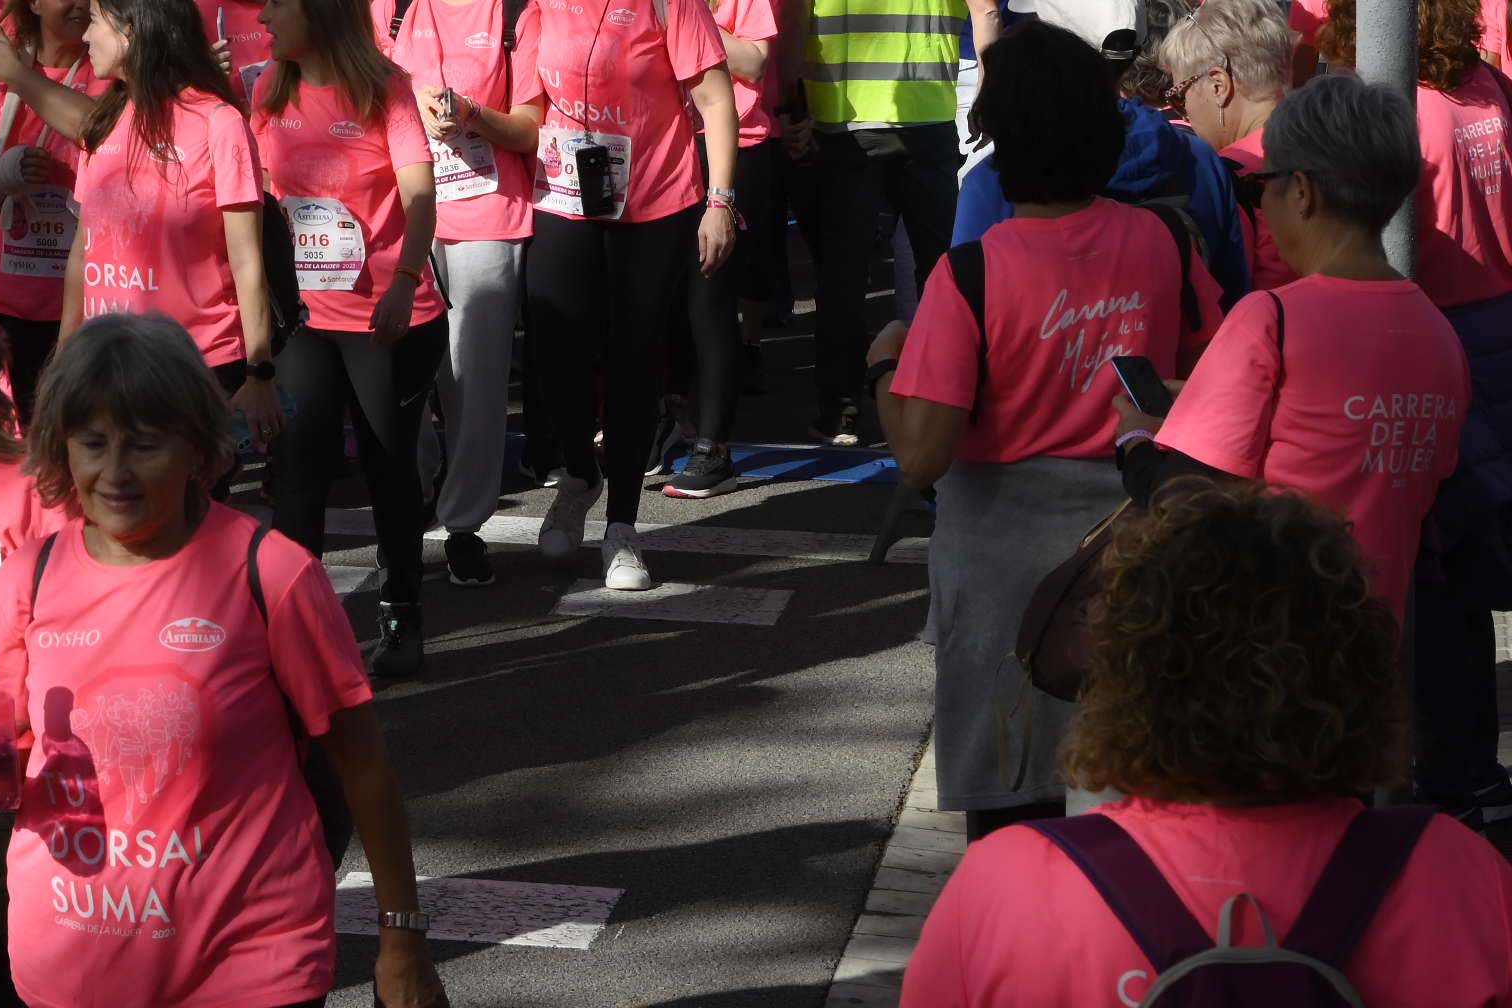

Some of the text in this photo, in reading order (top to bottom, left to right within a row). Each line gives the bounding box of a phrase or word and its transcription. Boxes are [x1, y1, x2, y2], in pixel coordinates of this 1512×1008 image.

[538, 66, 562, 89] TU
[1468, 138, 1505, 160] DE LA
[439, 163, 460, 175] 3836
[29, 222, 65, 235] 016
[298, 233, 330, 248] 016
[303, 250, 324, 260] 5035
[1039, 288, 1144, 340] Carrera
[1118, 319, 1145, 335] de la
[1057, 327, 1133, 394] Mujer
[1343, 393, 1457, 420] CARRERA
[1370, 420, 1437, 446] DE LA
[1360, 447, 1434, 474] MUJER
[38, 629, 101, 649] OYSHO
[164, 630, 222, 644] ASTURIANA
[42, 770, 87, 808] TU
[50, 821, 206, 870] DORSAL
[51, 876, 171, 924] SUMA
[55, 914, 86, 932] CARRERA
[110, 926, 143, 937] MUJER
